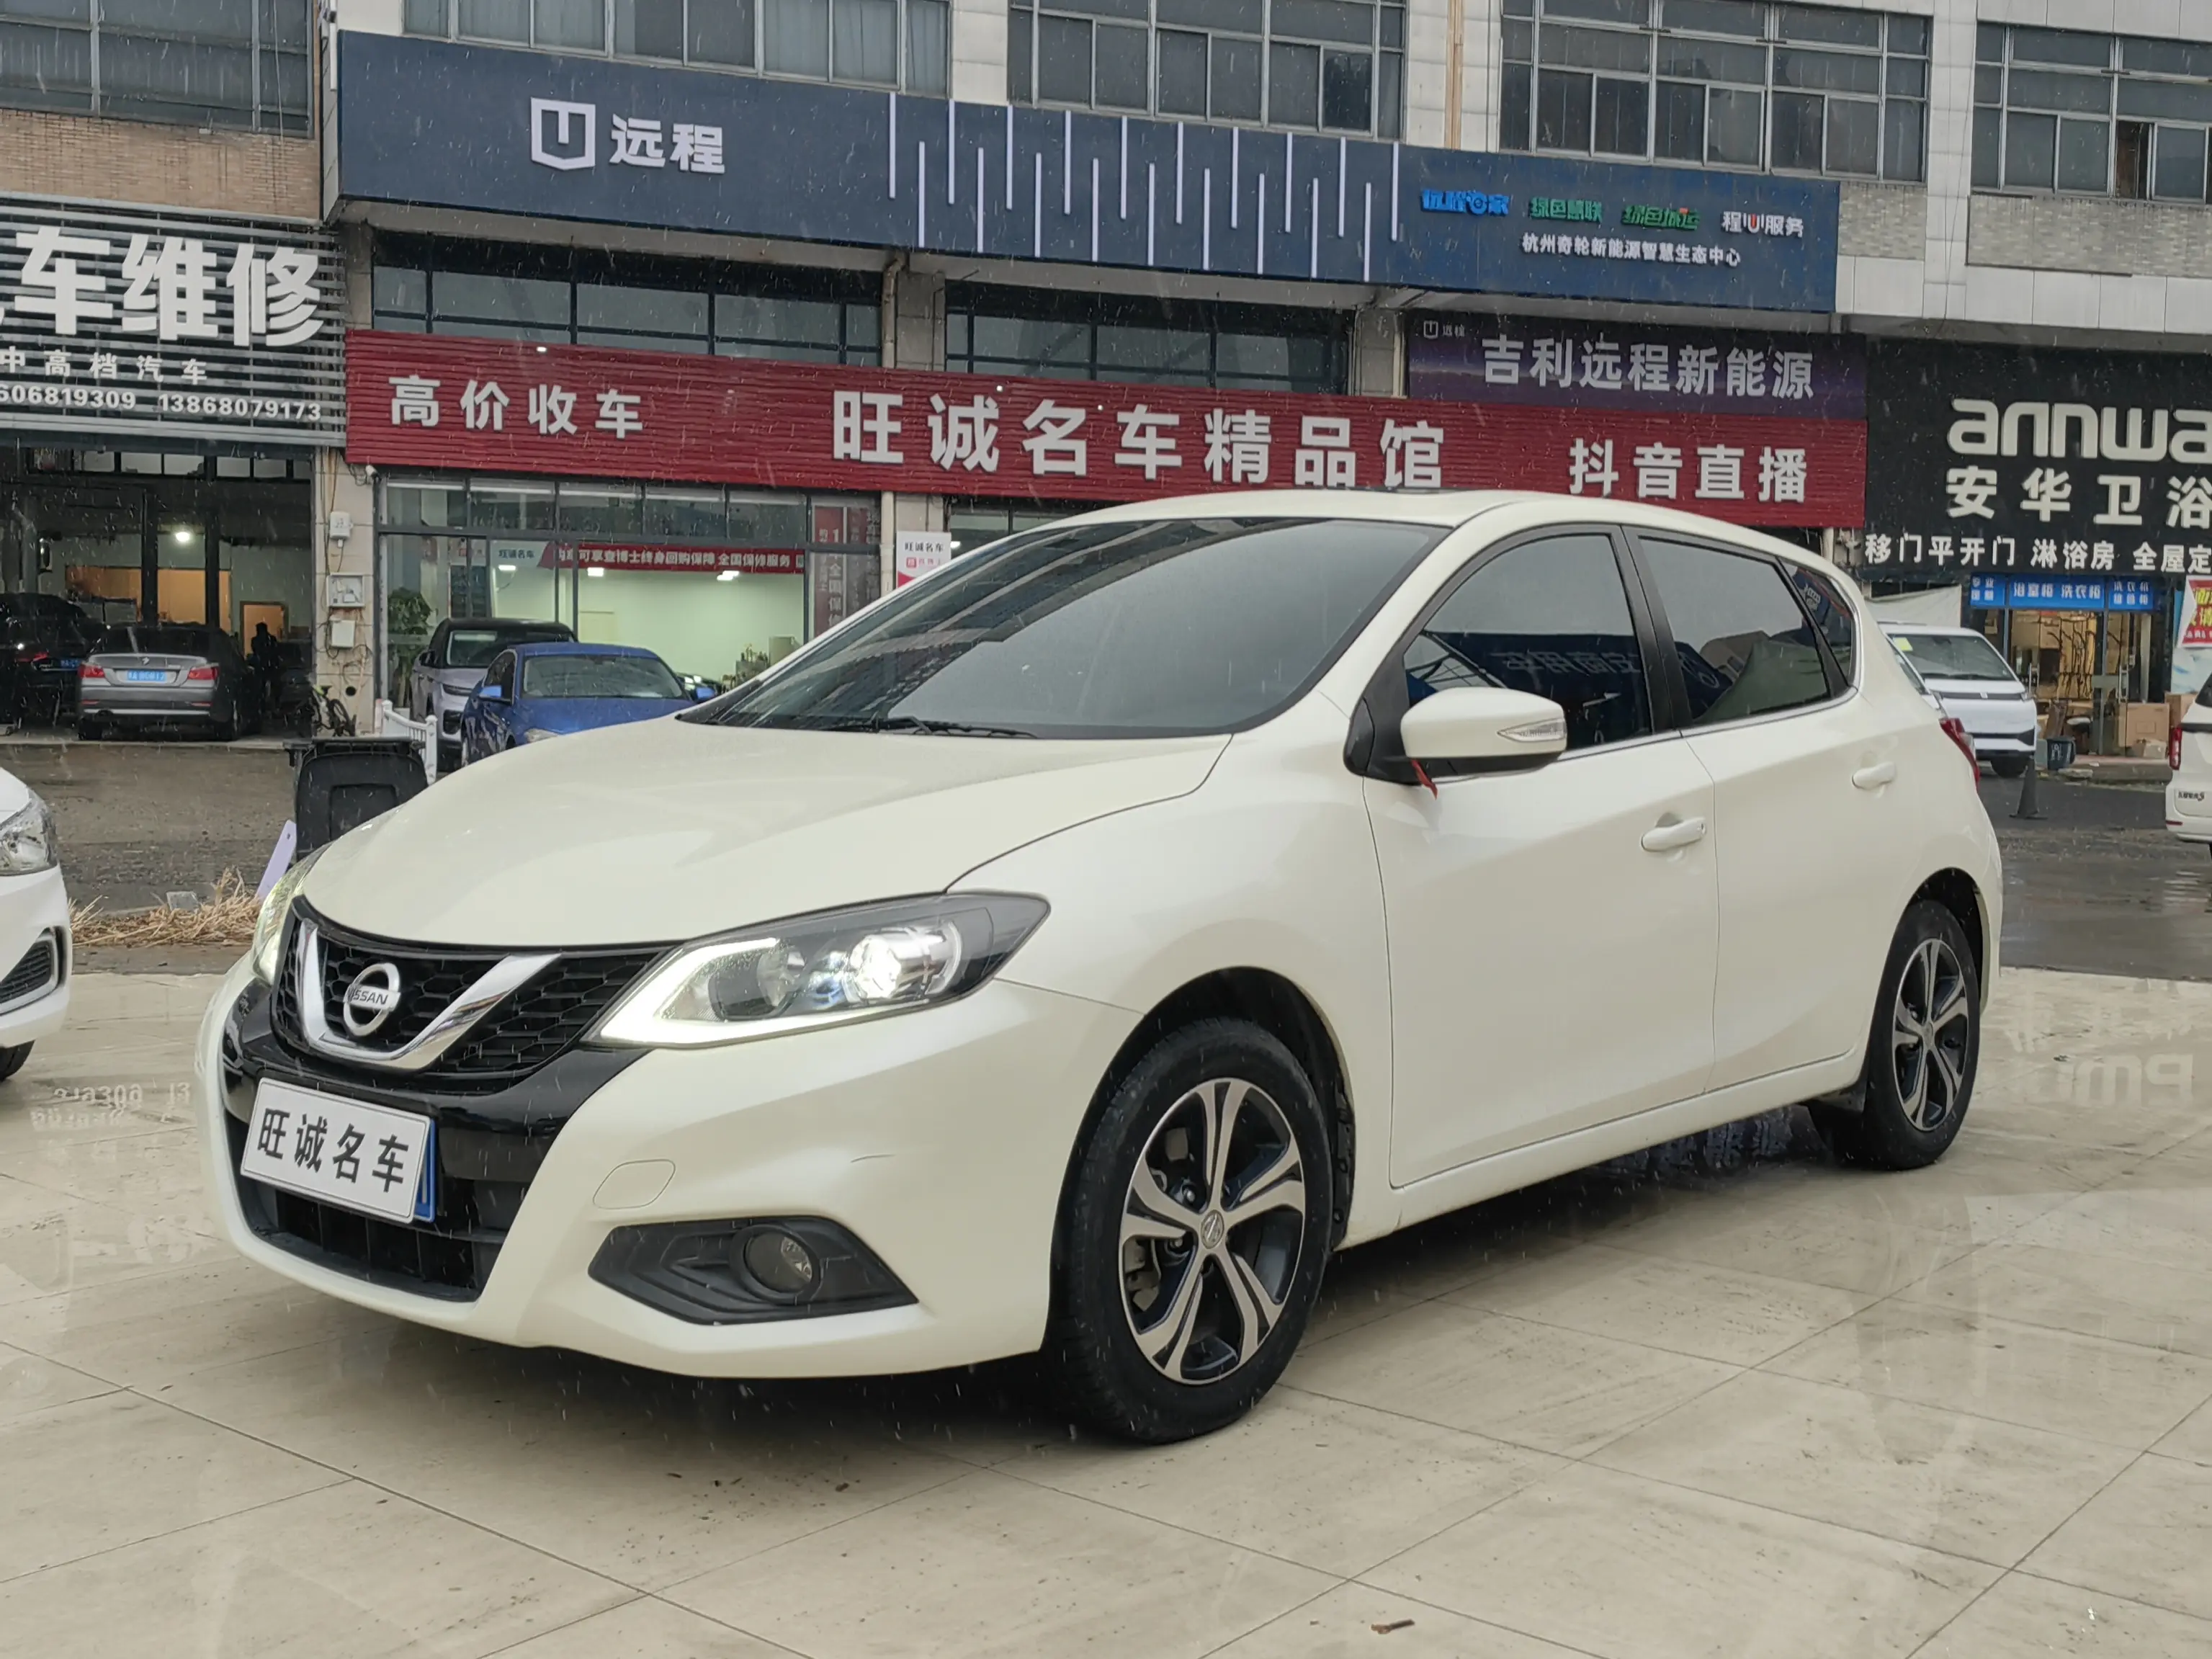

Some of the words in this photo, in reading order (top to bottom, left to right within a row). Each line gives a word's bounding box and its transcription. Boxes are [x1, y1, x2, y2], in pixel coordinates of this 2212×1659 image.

[609, 113, 725, 174] 远程
[0, 226, 324, 347] 车维修
[1482, 332, 1814, 400] 吉利远程新能源
[158, 393, 322, 421] 13868079173
[388, 375, 643, 439] 高价收车
[832, 390, 1444, 489] 旺诚名车精品馆
[1947, 398, 2212, 465] annwa
[1569, 437, 1808, 503] 抖音直播
[1945, 465, 2212, 529] 安华卫浴
[1865, 534, 2015, 566] 移门平开门
[2030, 538, 2115, 571] 淋浴房
[2132, 541, 2212, 573] 全屋定
[348, 988, 389, 1005] NISSAN
[256, 1107, 409, 1193] 旺诚名车
